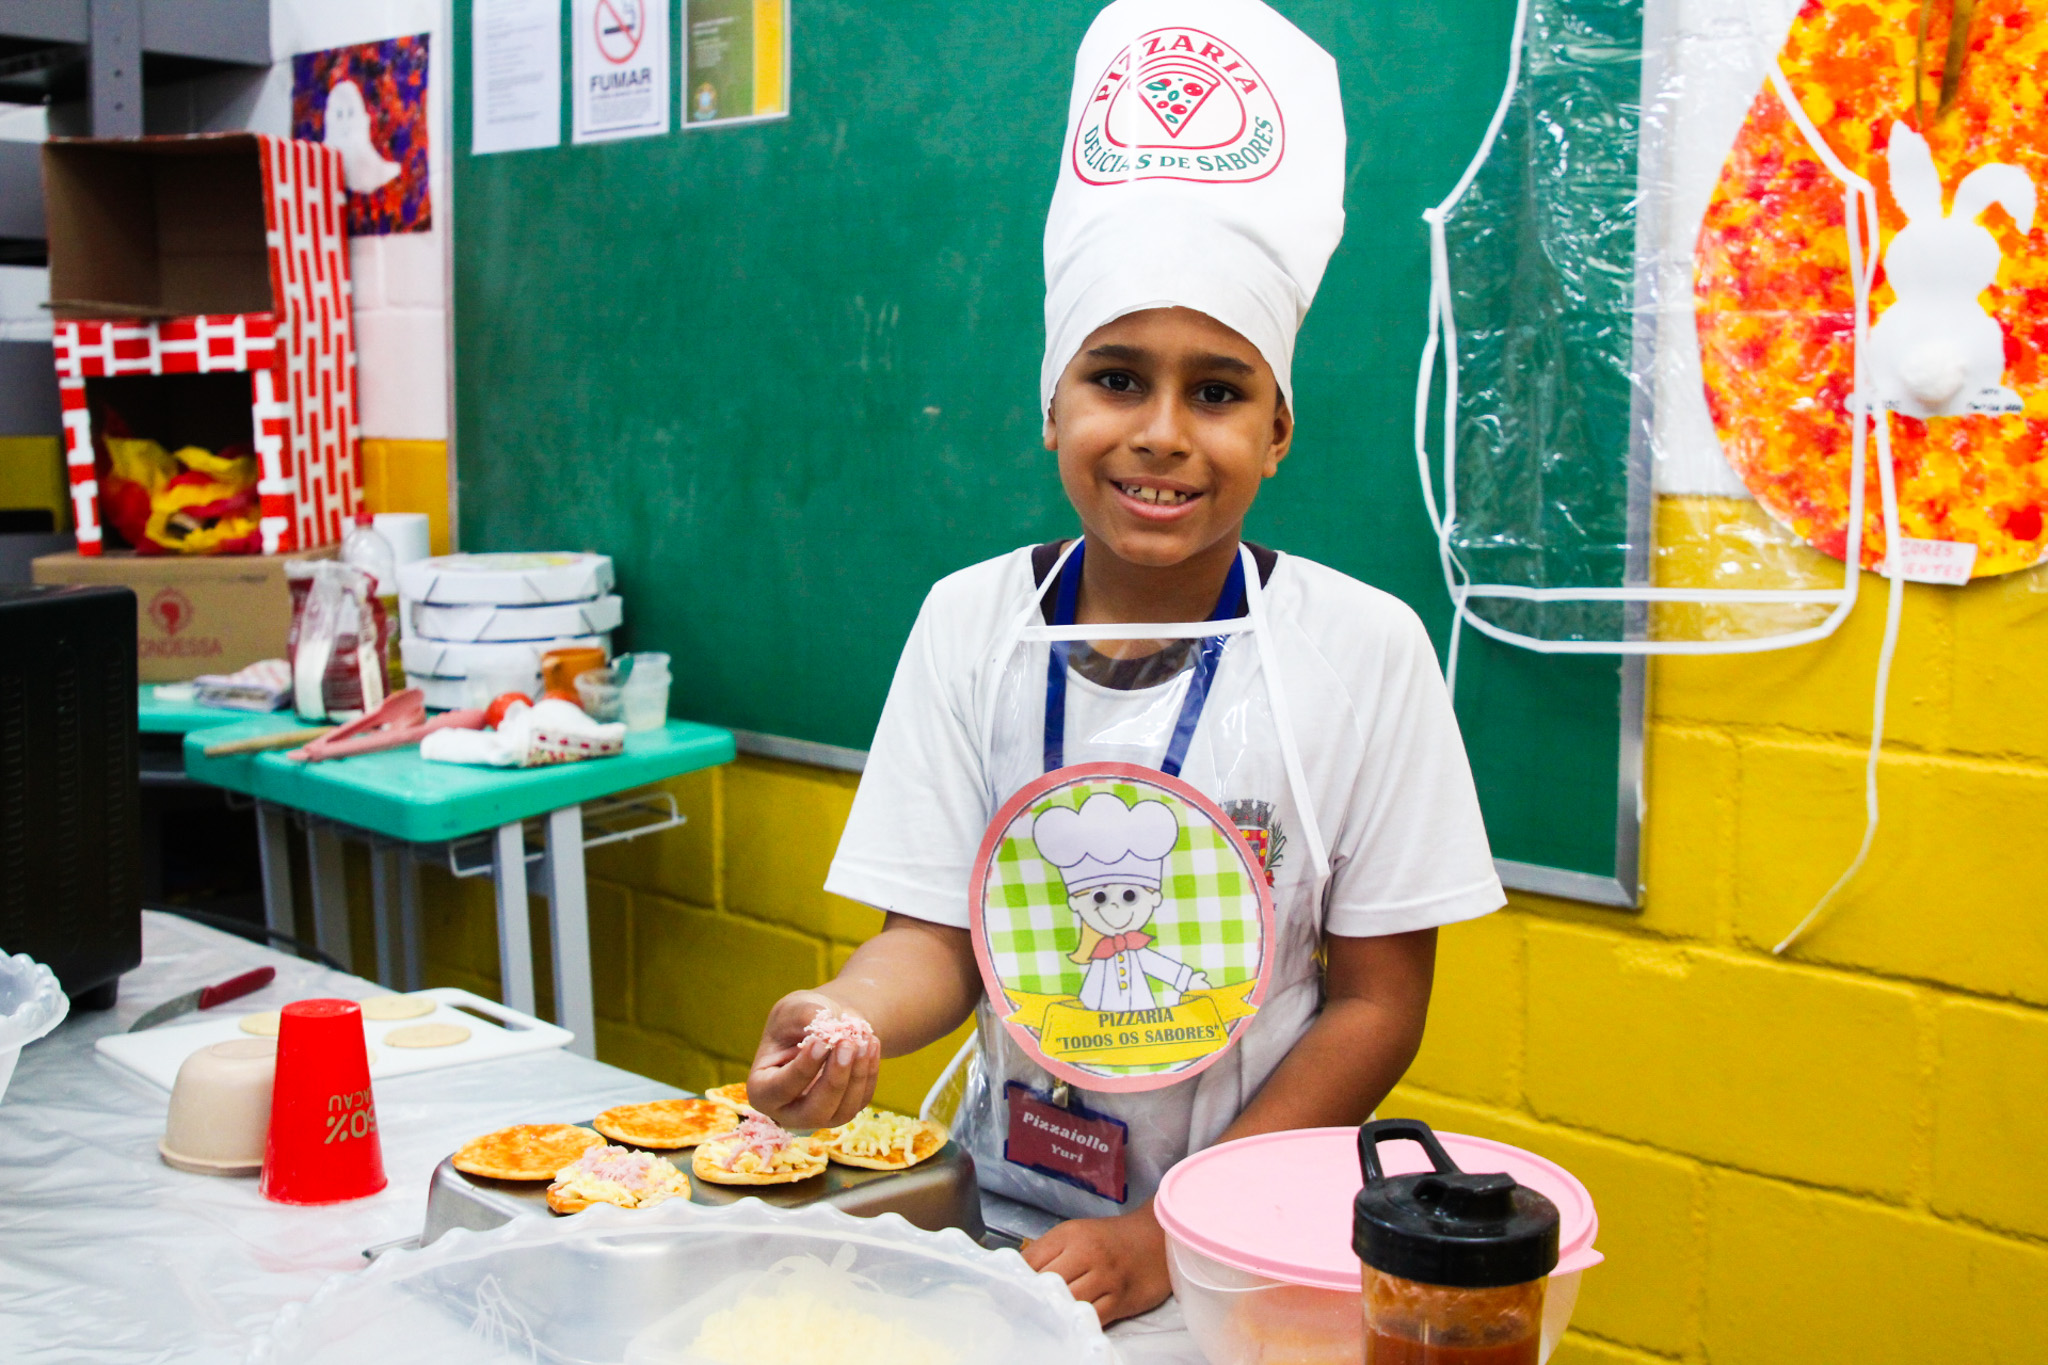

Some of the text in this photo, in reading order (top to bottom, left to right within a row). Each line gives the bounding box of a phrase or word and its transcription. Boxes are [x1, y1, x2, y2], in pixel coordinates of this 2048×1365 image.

[589, 67, 652, 93] FUMAR
[1159, 156, 1191, 169] DE
[1196, 116, 1274, 172] SABORES
[1099, 1007, 1174, 1028] PIZZARIA
[1056, 1023, 1219, 1050] "TODOS OS SABORES"
[1022, 1111, 1109, 1154] Pizzaiollo
[1051, 1143, 1084, 1164] Yuri
